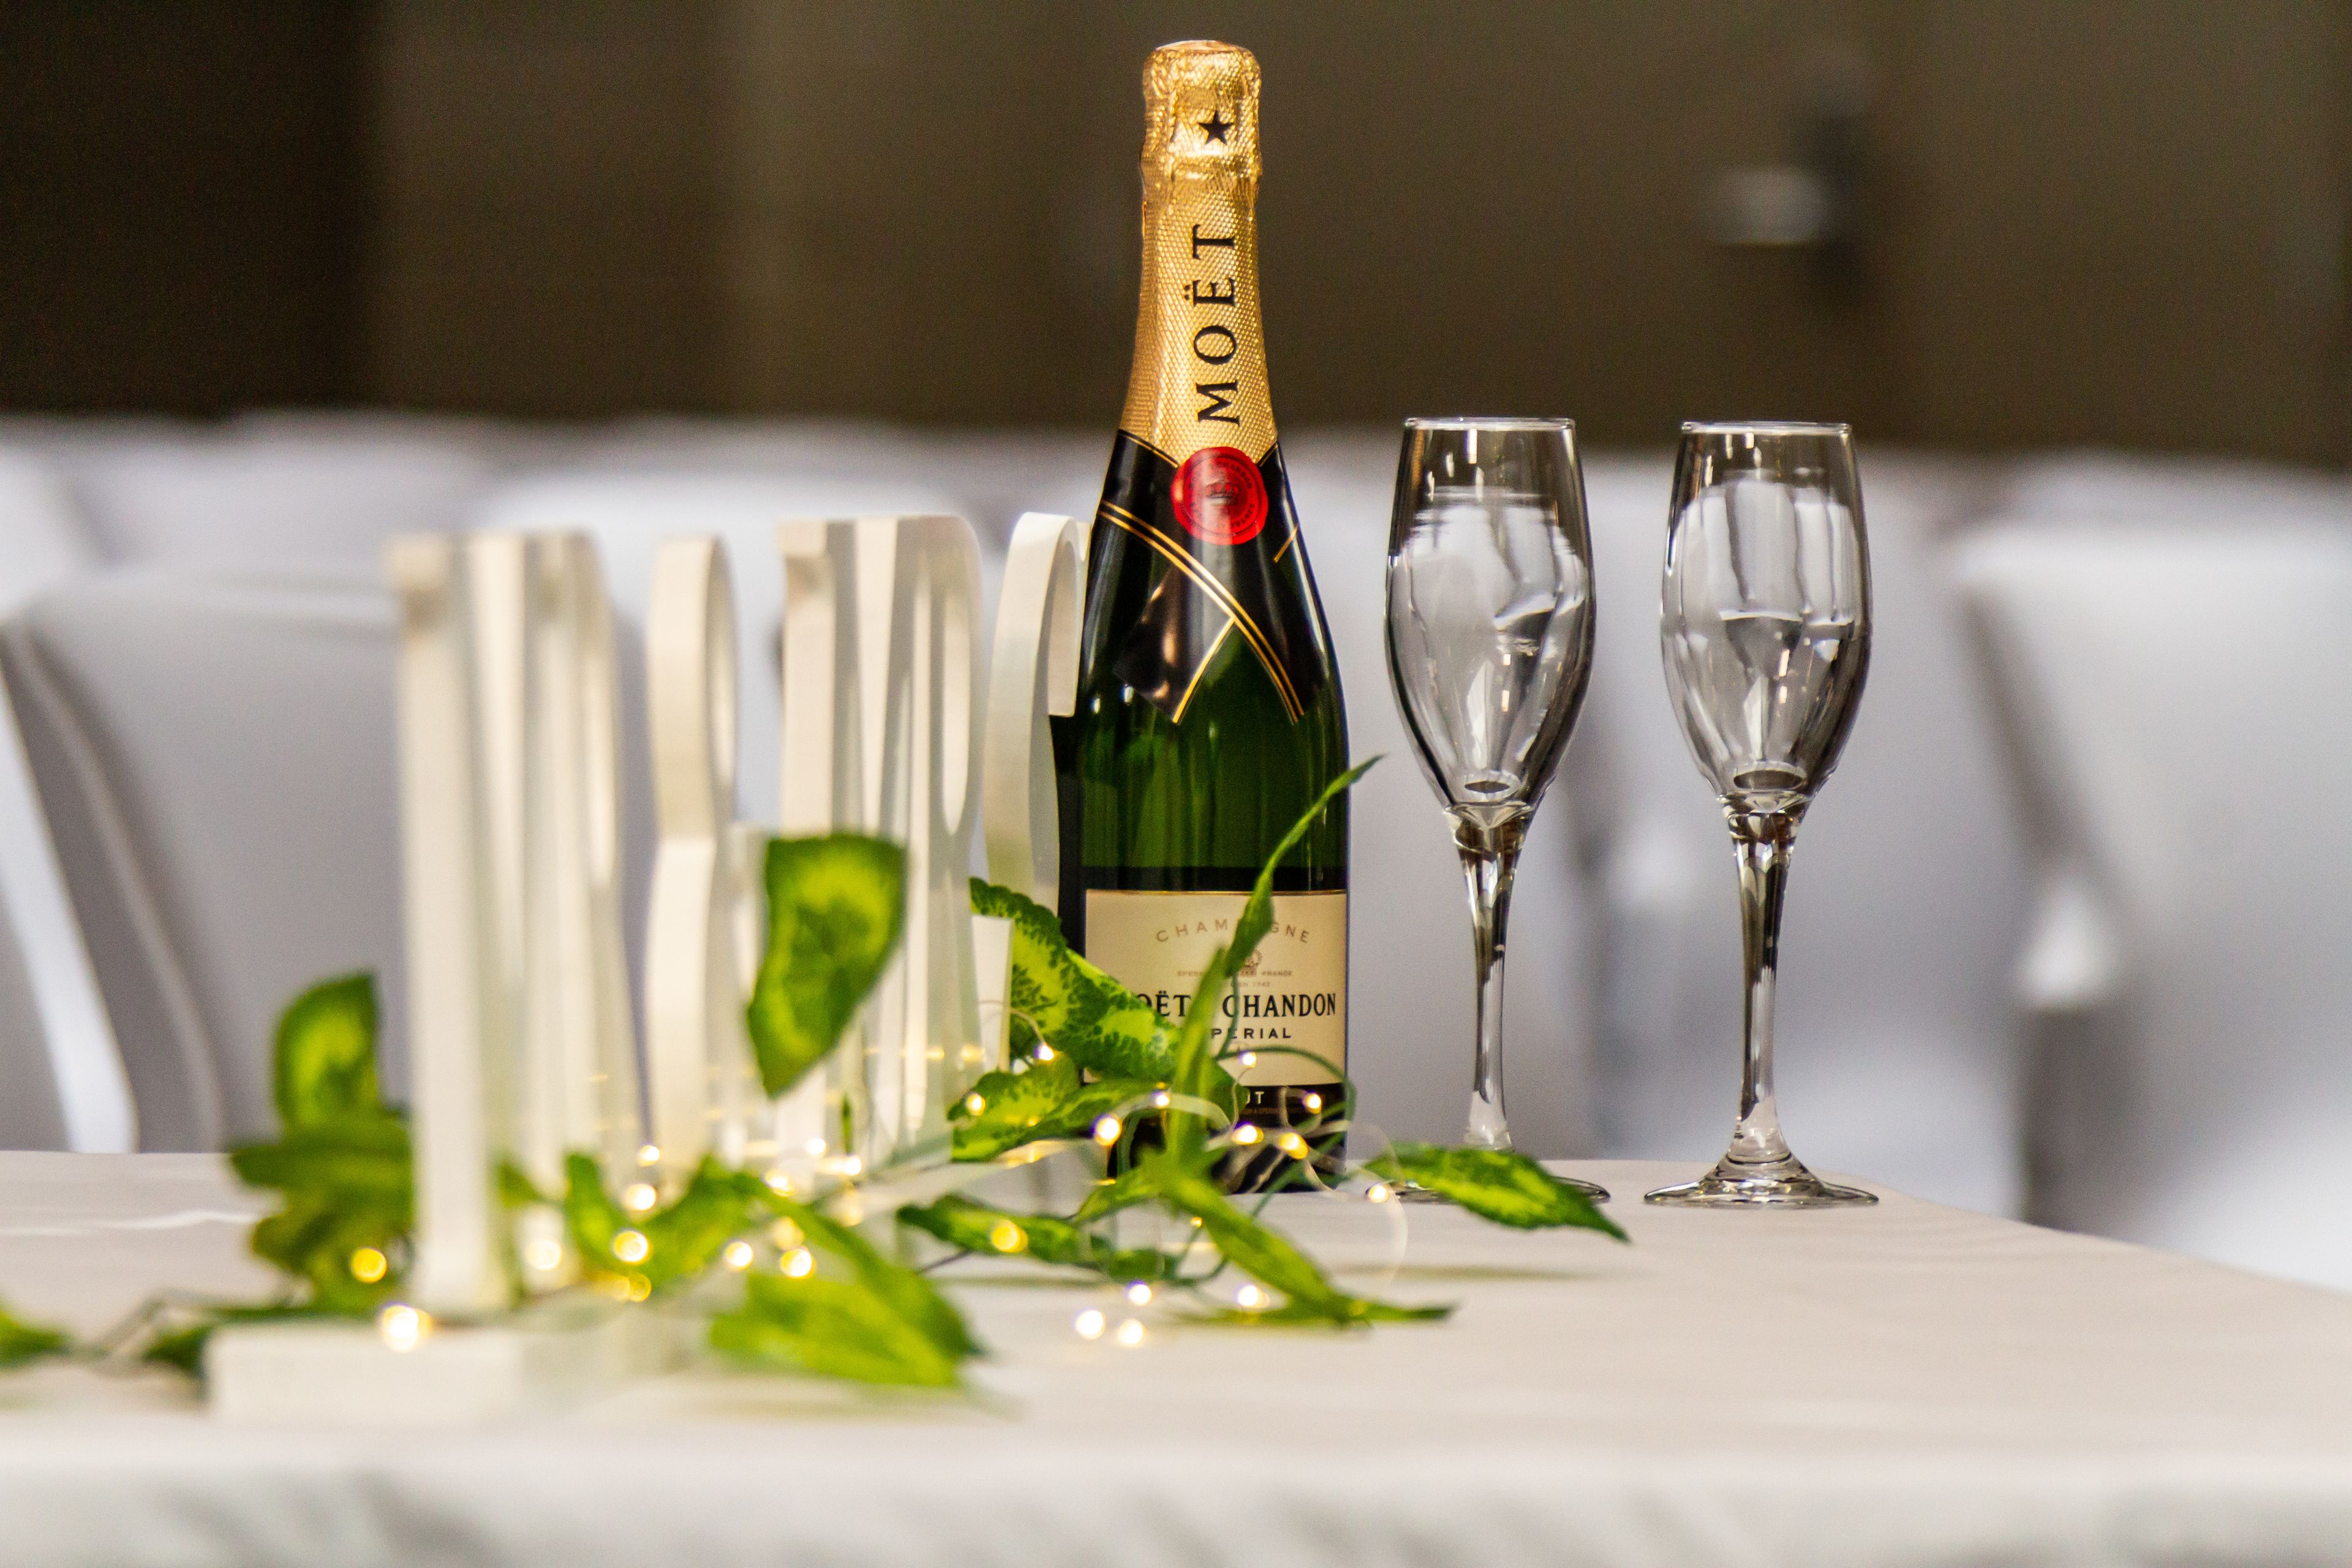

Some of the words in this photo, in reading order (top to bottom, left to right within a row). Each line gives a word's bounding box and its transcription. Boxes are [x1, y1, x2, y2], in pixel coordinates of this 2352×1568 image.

[1184, 224, 1240, 426] MOËT
[1156, 919, 1310, 944] CHAMGNE
[1137, 990, 1191, 1017] ËT
[1222, 993, 1336, 1018] CHANDON
[1211, 1027, 1292, 1039] PRIAL
